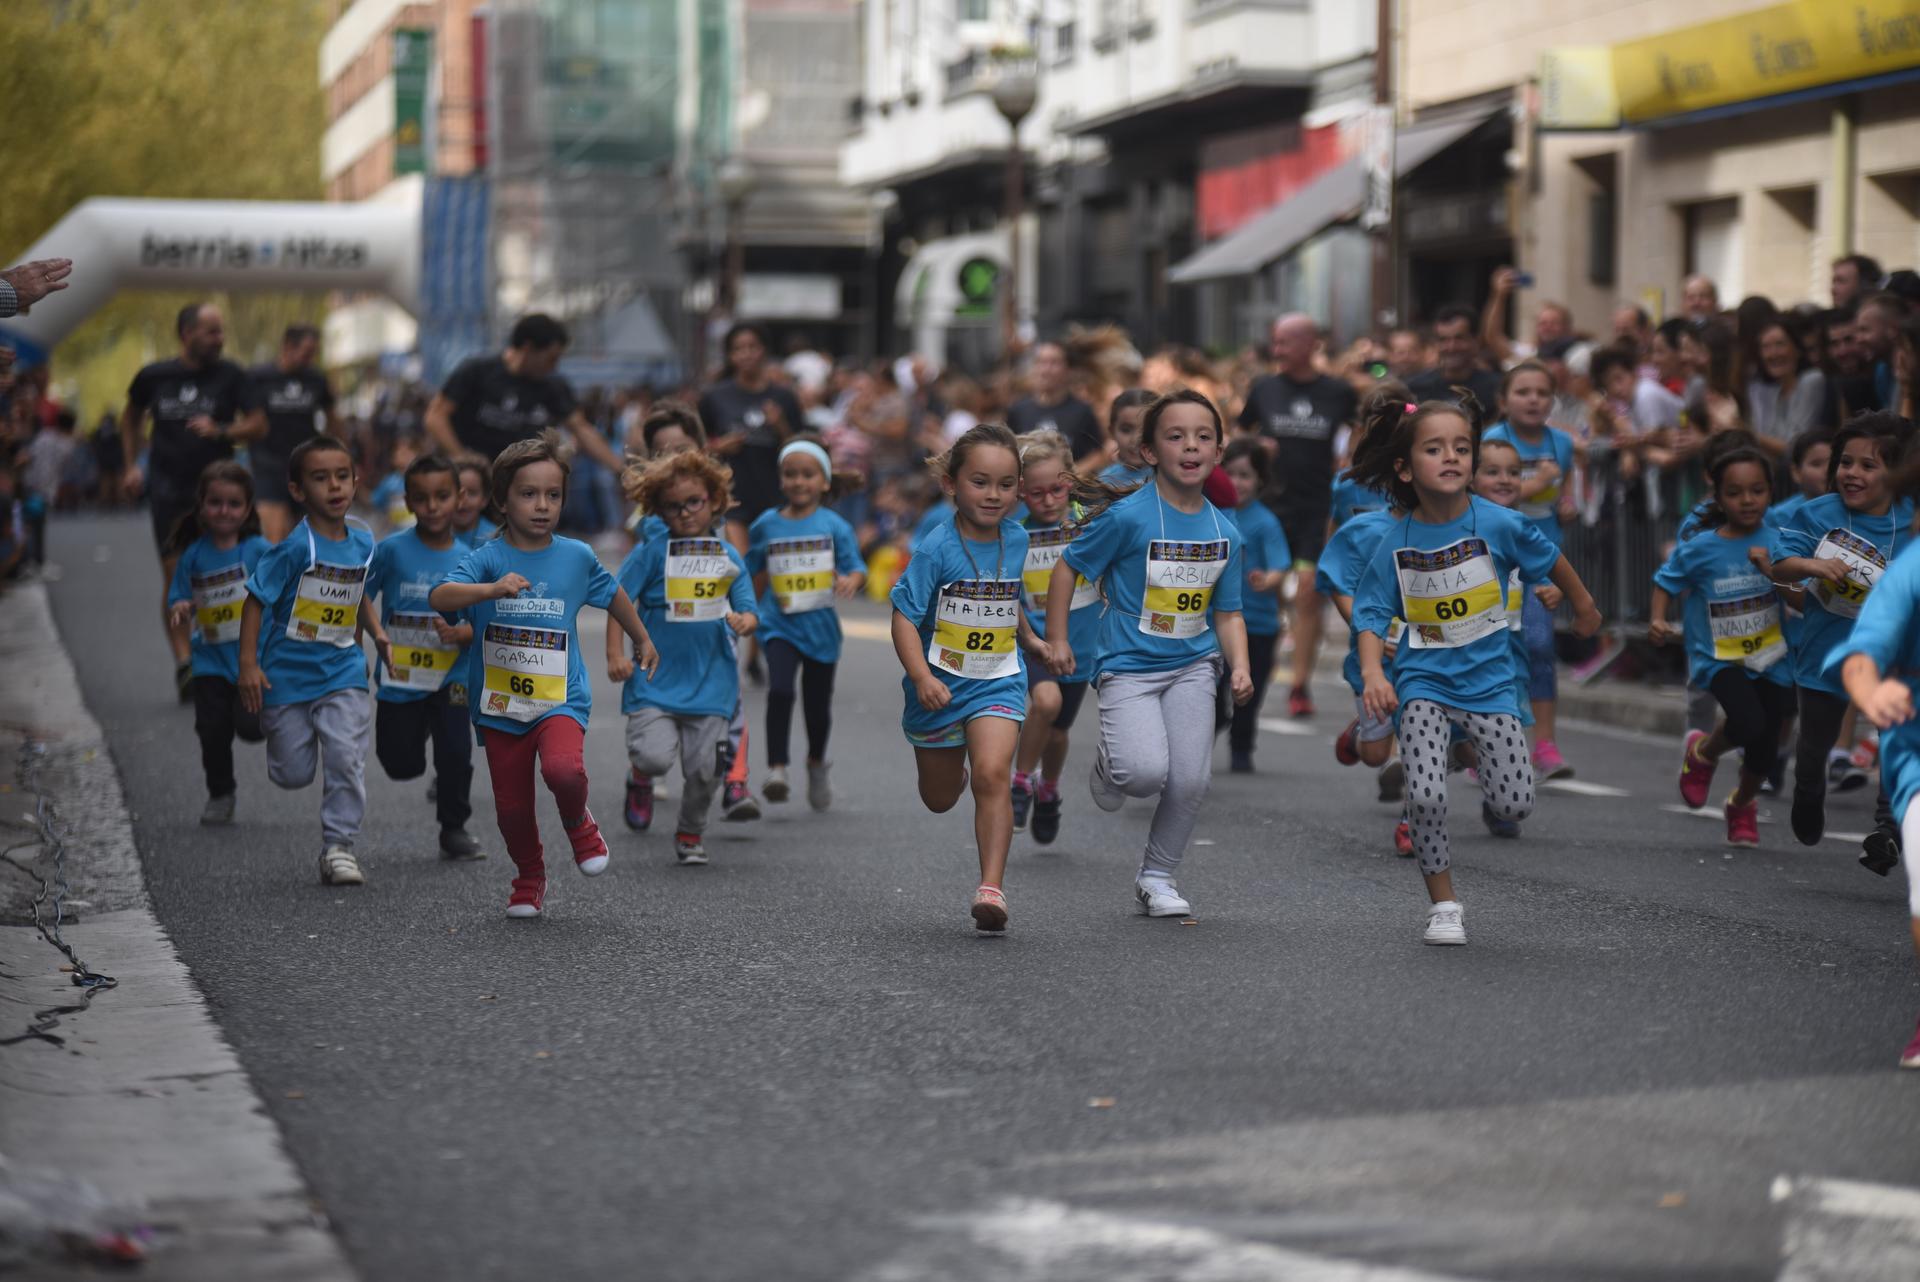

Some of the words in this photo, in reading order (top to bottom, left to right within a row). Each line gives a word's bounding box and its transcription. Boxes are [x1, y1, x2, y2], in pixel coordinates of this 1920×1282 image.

[785, 576, 816, 591] 101
[1160, 565, 1216, 585] ARBIL
[319, 584, 351, 600] UNAI
[694, 582, 717, 597] 53
[1176, 593, 1203, 611] 96
[1435, 598, 1468, 620] 60
[212, 605, 234, 623] 30
[321, 607, 345, 625] 32
[966, 632, 995, 651] 82
[410, 651, 434, 668] 95
[494, 647, 544, 667] GABAI
[510, 675, 535, 696] 66
